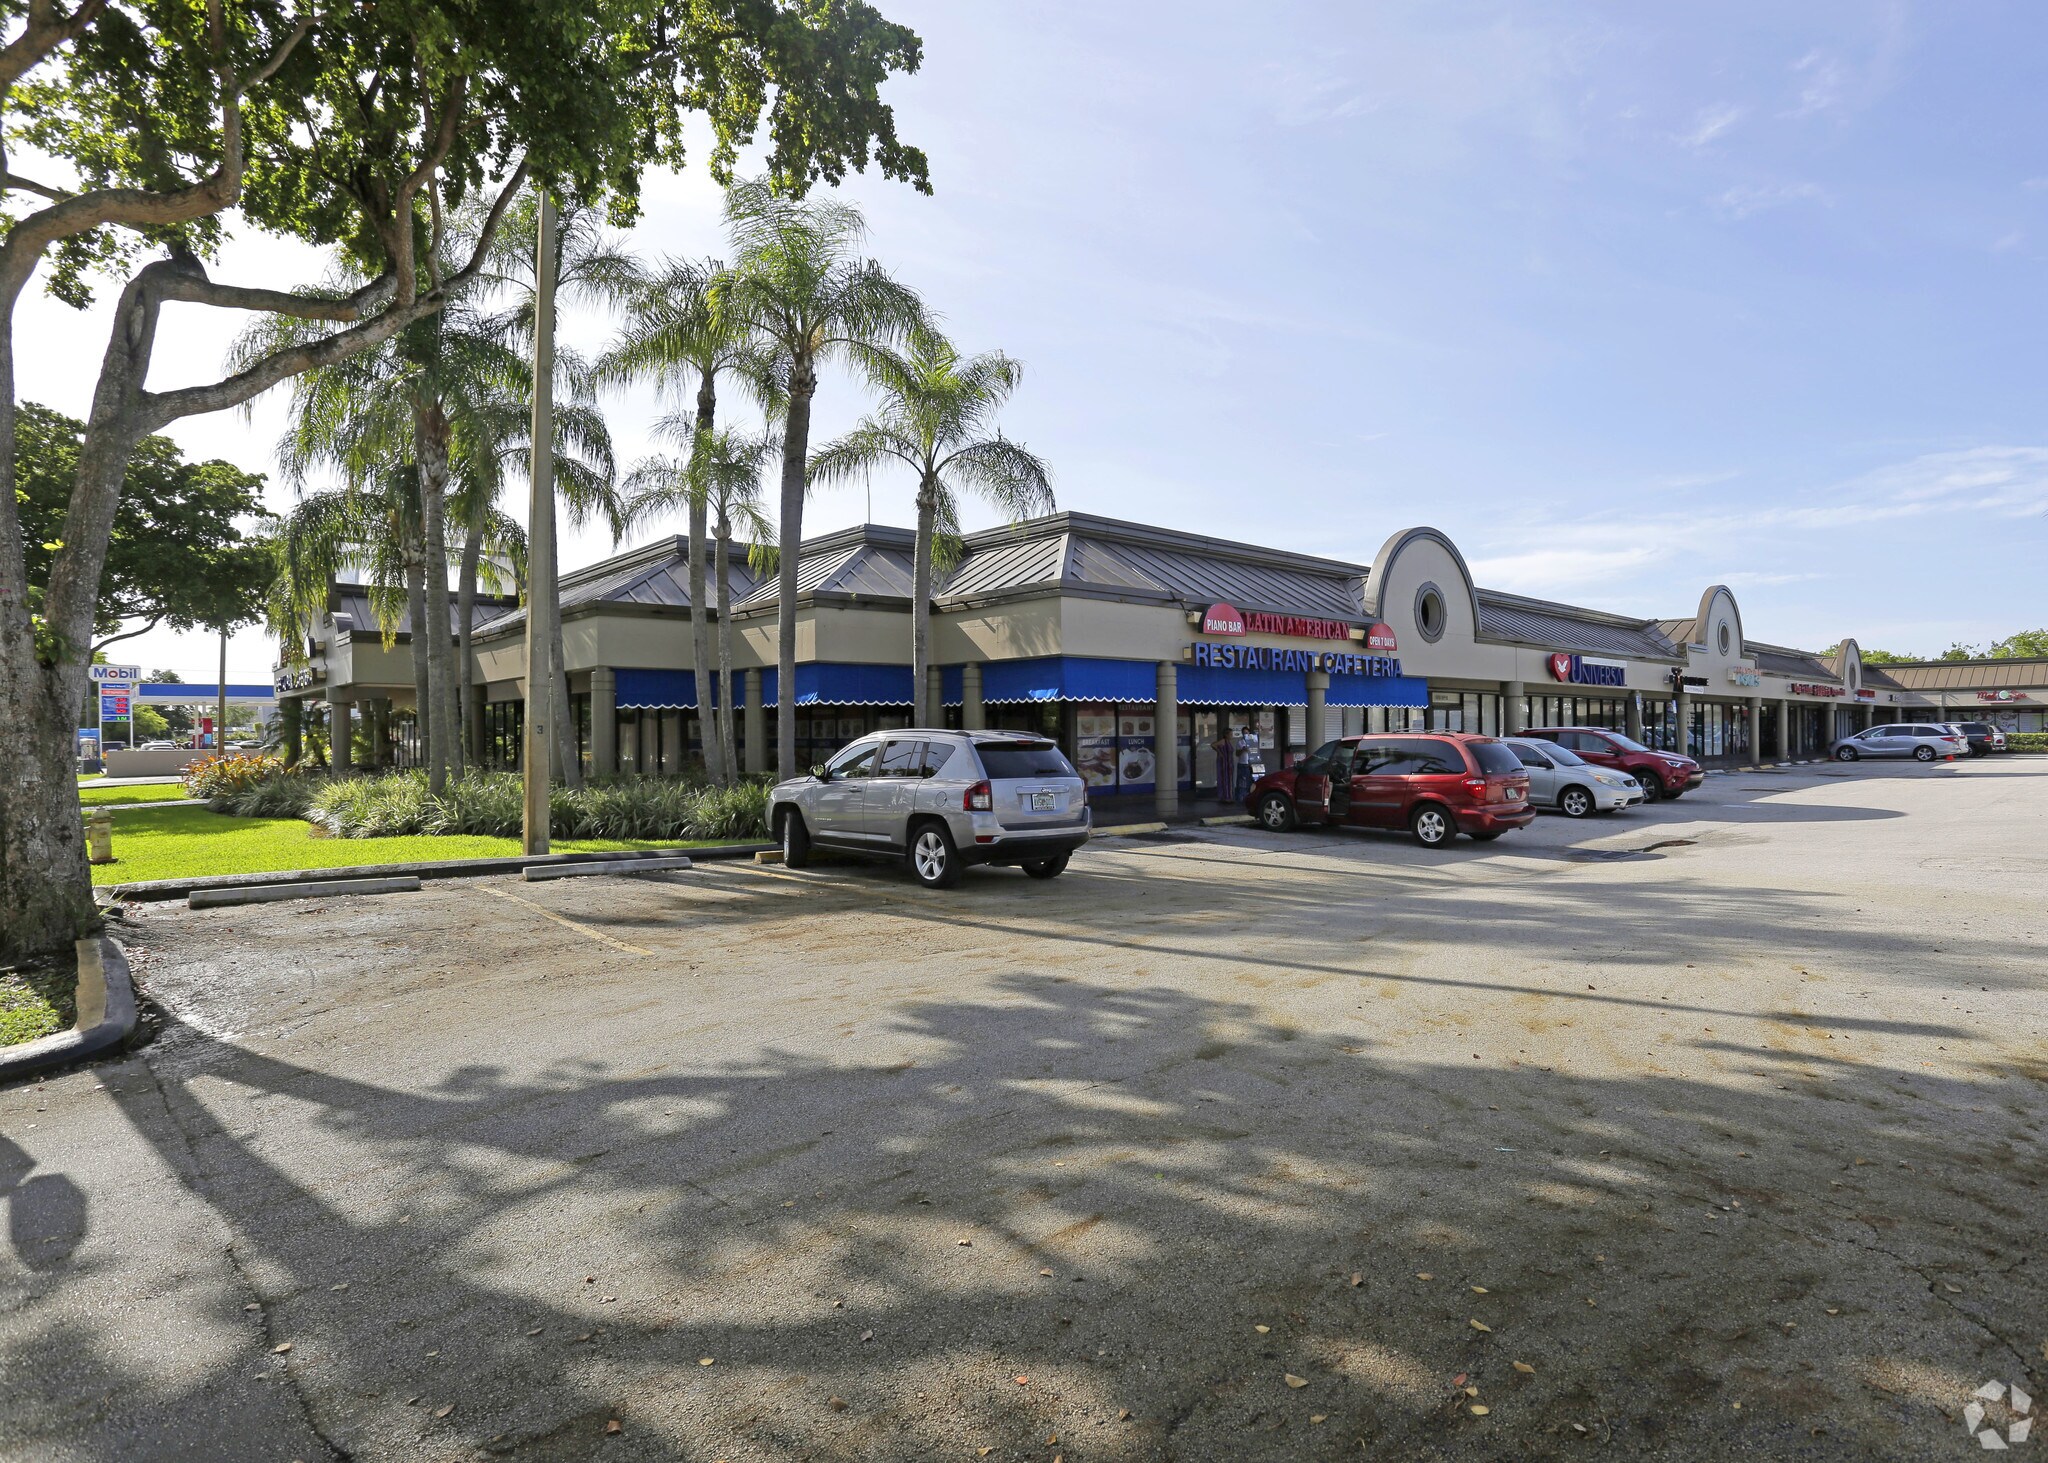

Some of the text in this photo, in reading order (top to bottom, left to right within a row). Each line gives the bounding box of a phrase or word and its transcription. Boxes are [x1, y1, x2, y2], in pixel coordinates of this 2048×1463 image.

[1207, 619, 1242, 632] PIANO BAR
[1246, 612, 1350, 640] LATIN AMERICAN
[1370, 636, 1380, 646] OPEN
[1384, 637, 1395, 647] DAYS
[1195, 642, 1403, 678] RESTAURANT CAFETERIA
[94, 668, 136, 678] Mobil
[537, 725, 543, 734] 3
